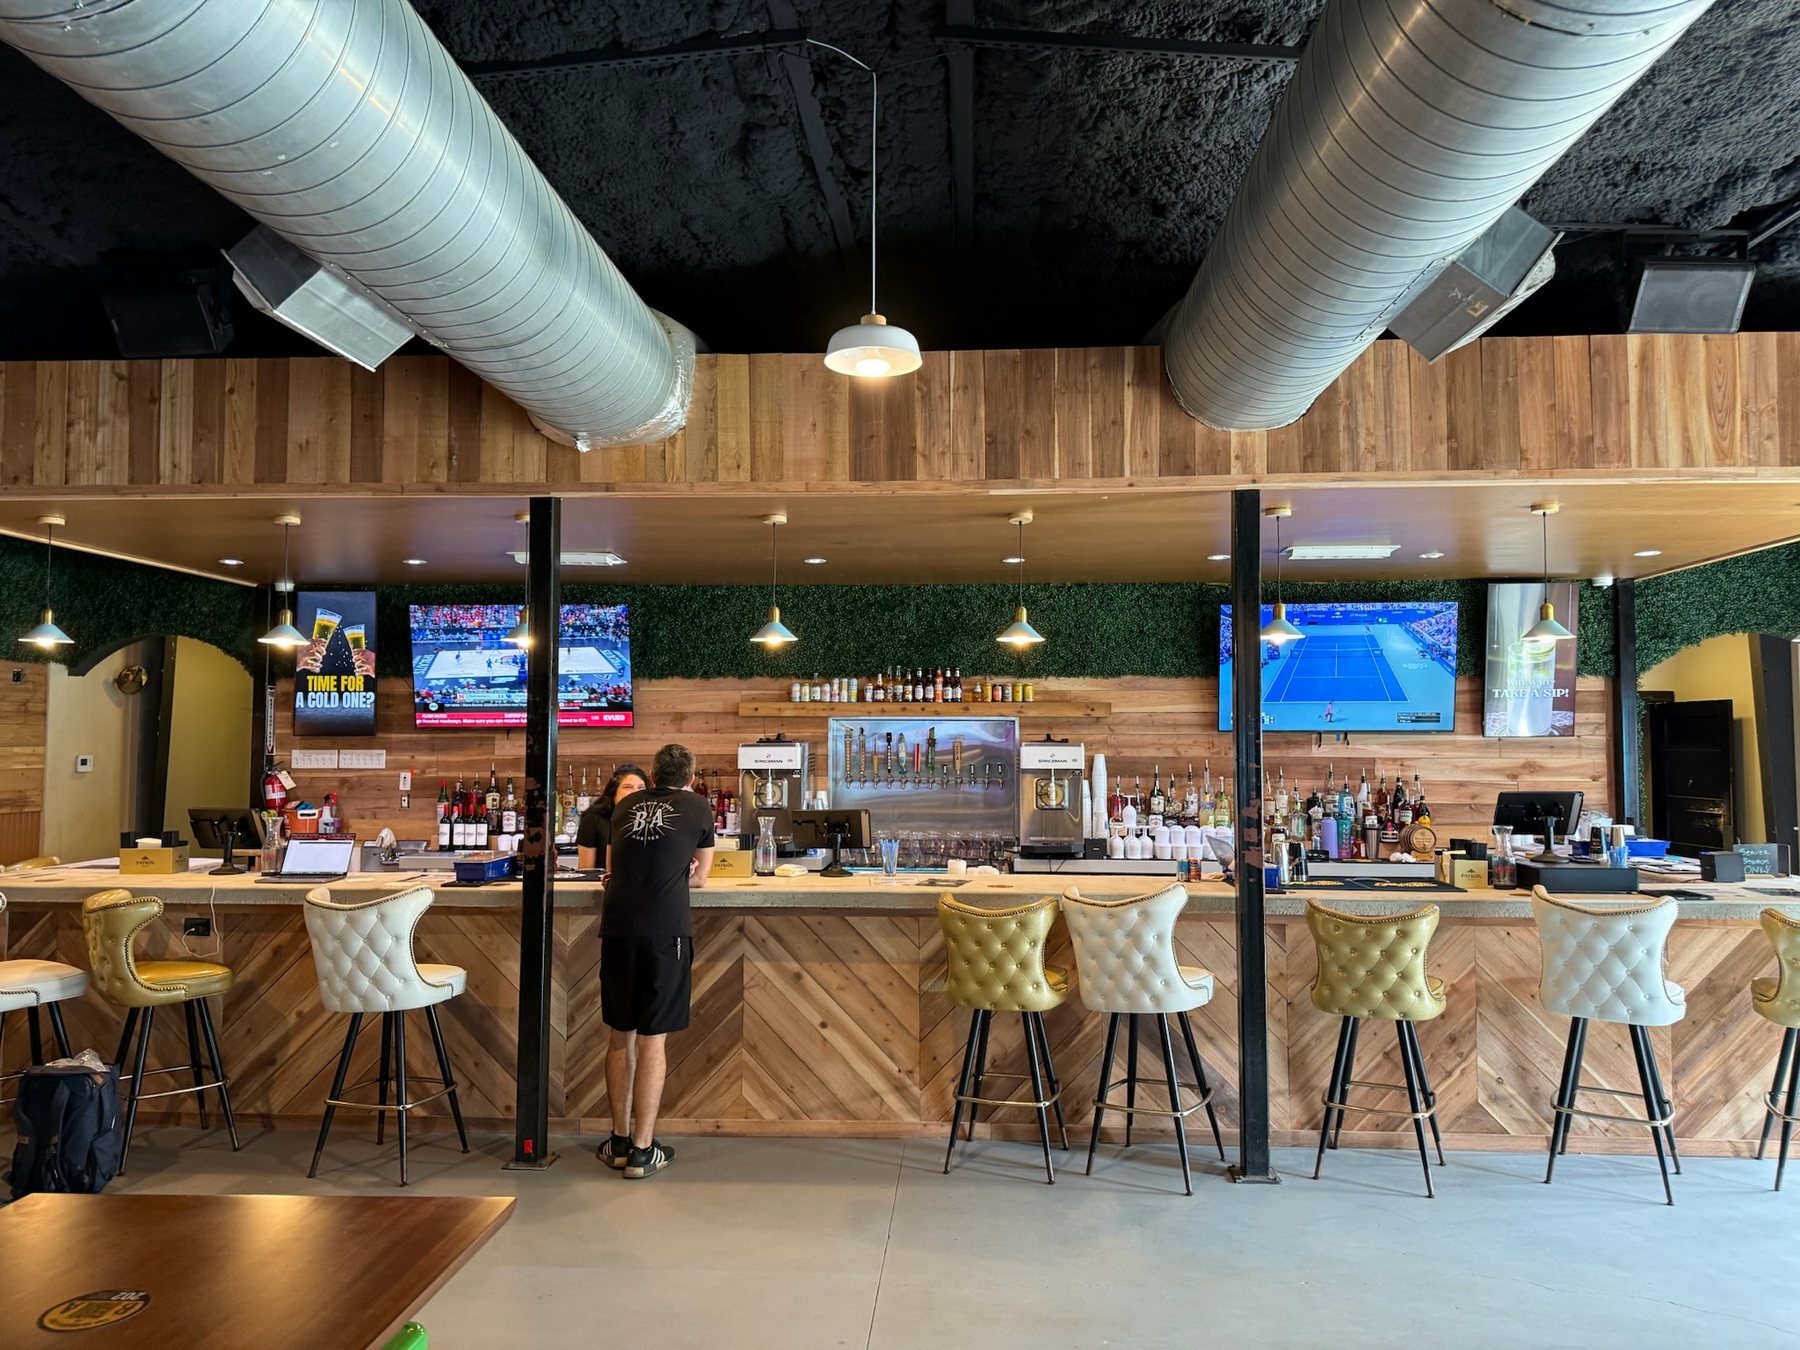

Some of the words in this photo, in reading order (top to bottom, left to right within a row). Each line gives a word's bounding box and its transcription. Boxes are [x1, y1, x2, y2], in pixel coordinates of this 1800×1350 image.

[306, 676, 338, 692] TIME
[340, 676, 364, 692] FOR
[296, 692, 304, 708] A
[308, 692, 340, 708] COLD
[342, 692, 375, 708] ONE?
[1492, 688, 1529, 698] TAKE
[1530, 688, 1541, 698] A
[1543, 688, 1570, 698] SIP!
